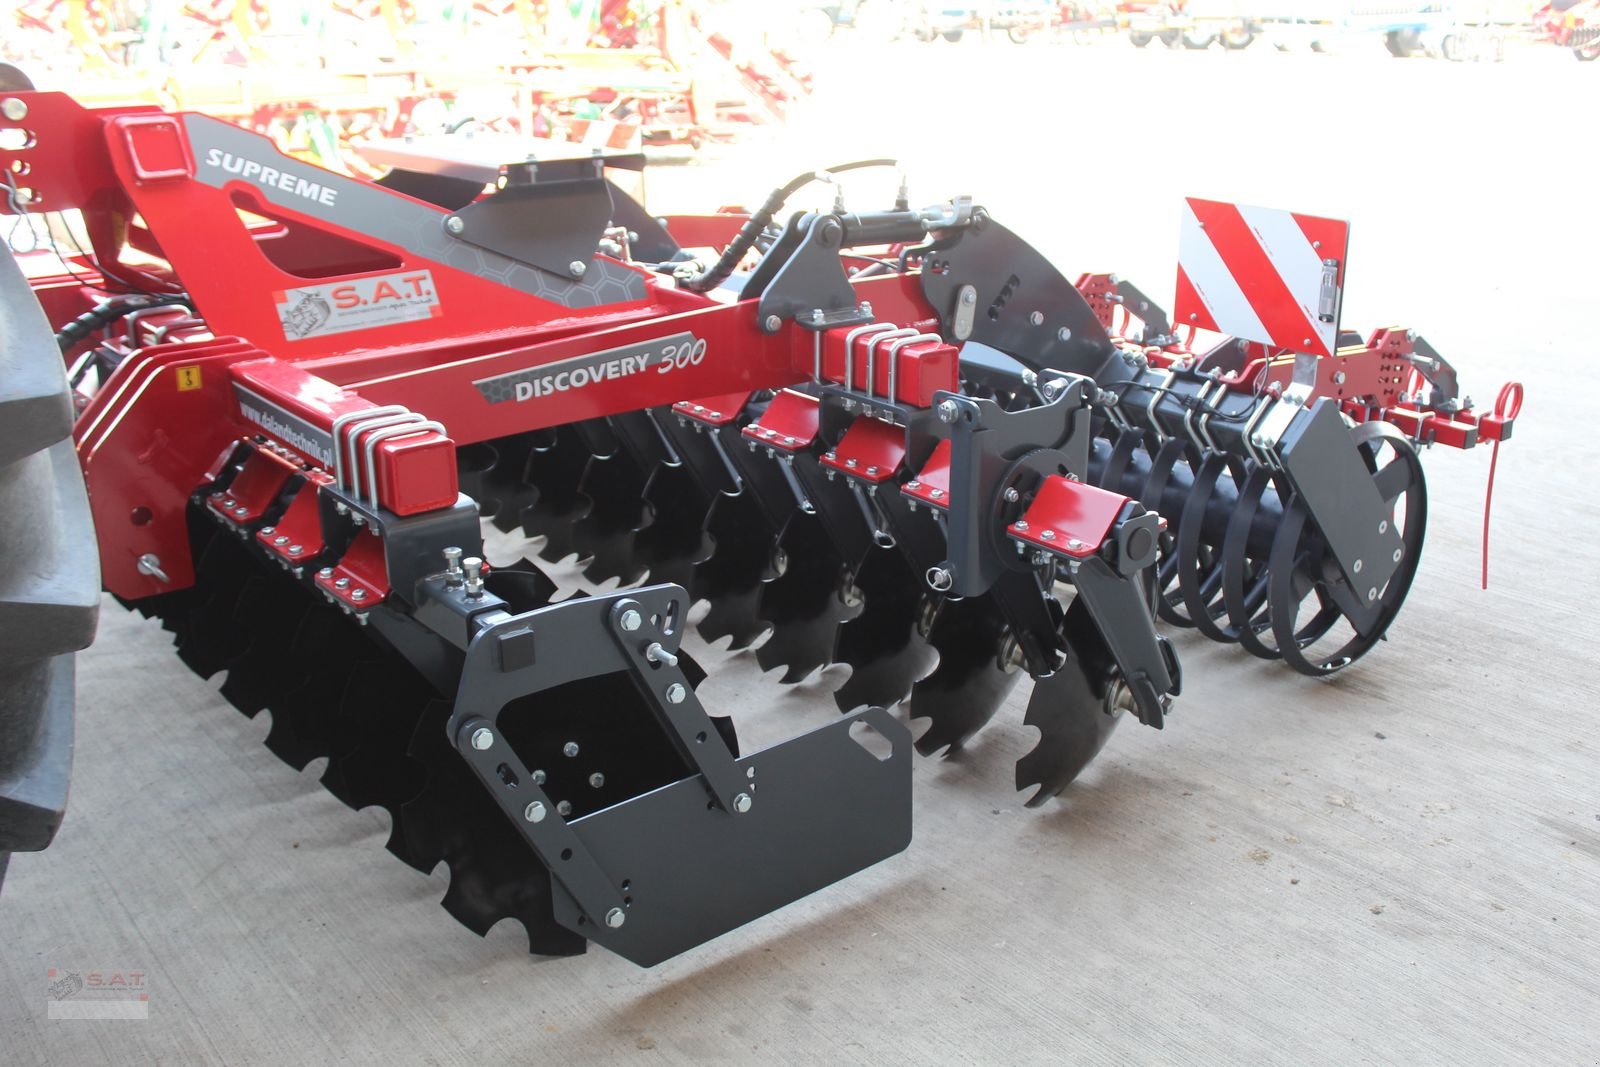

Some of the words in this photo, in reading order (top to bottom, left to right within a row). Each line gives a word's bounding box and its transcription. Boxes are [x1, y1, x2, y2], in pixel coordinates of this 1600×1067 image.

[205, 148, 338, 206] SUPREME
[331, 274, 432, 309] S.A.T.
[515, 352, 650, 402] DISCOVERY
[657, 338, 707, 374] 300
[239, 401, 333, 471] www.dalandtechnik.pl
